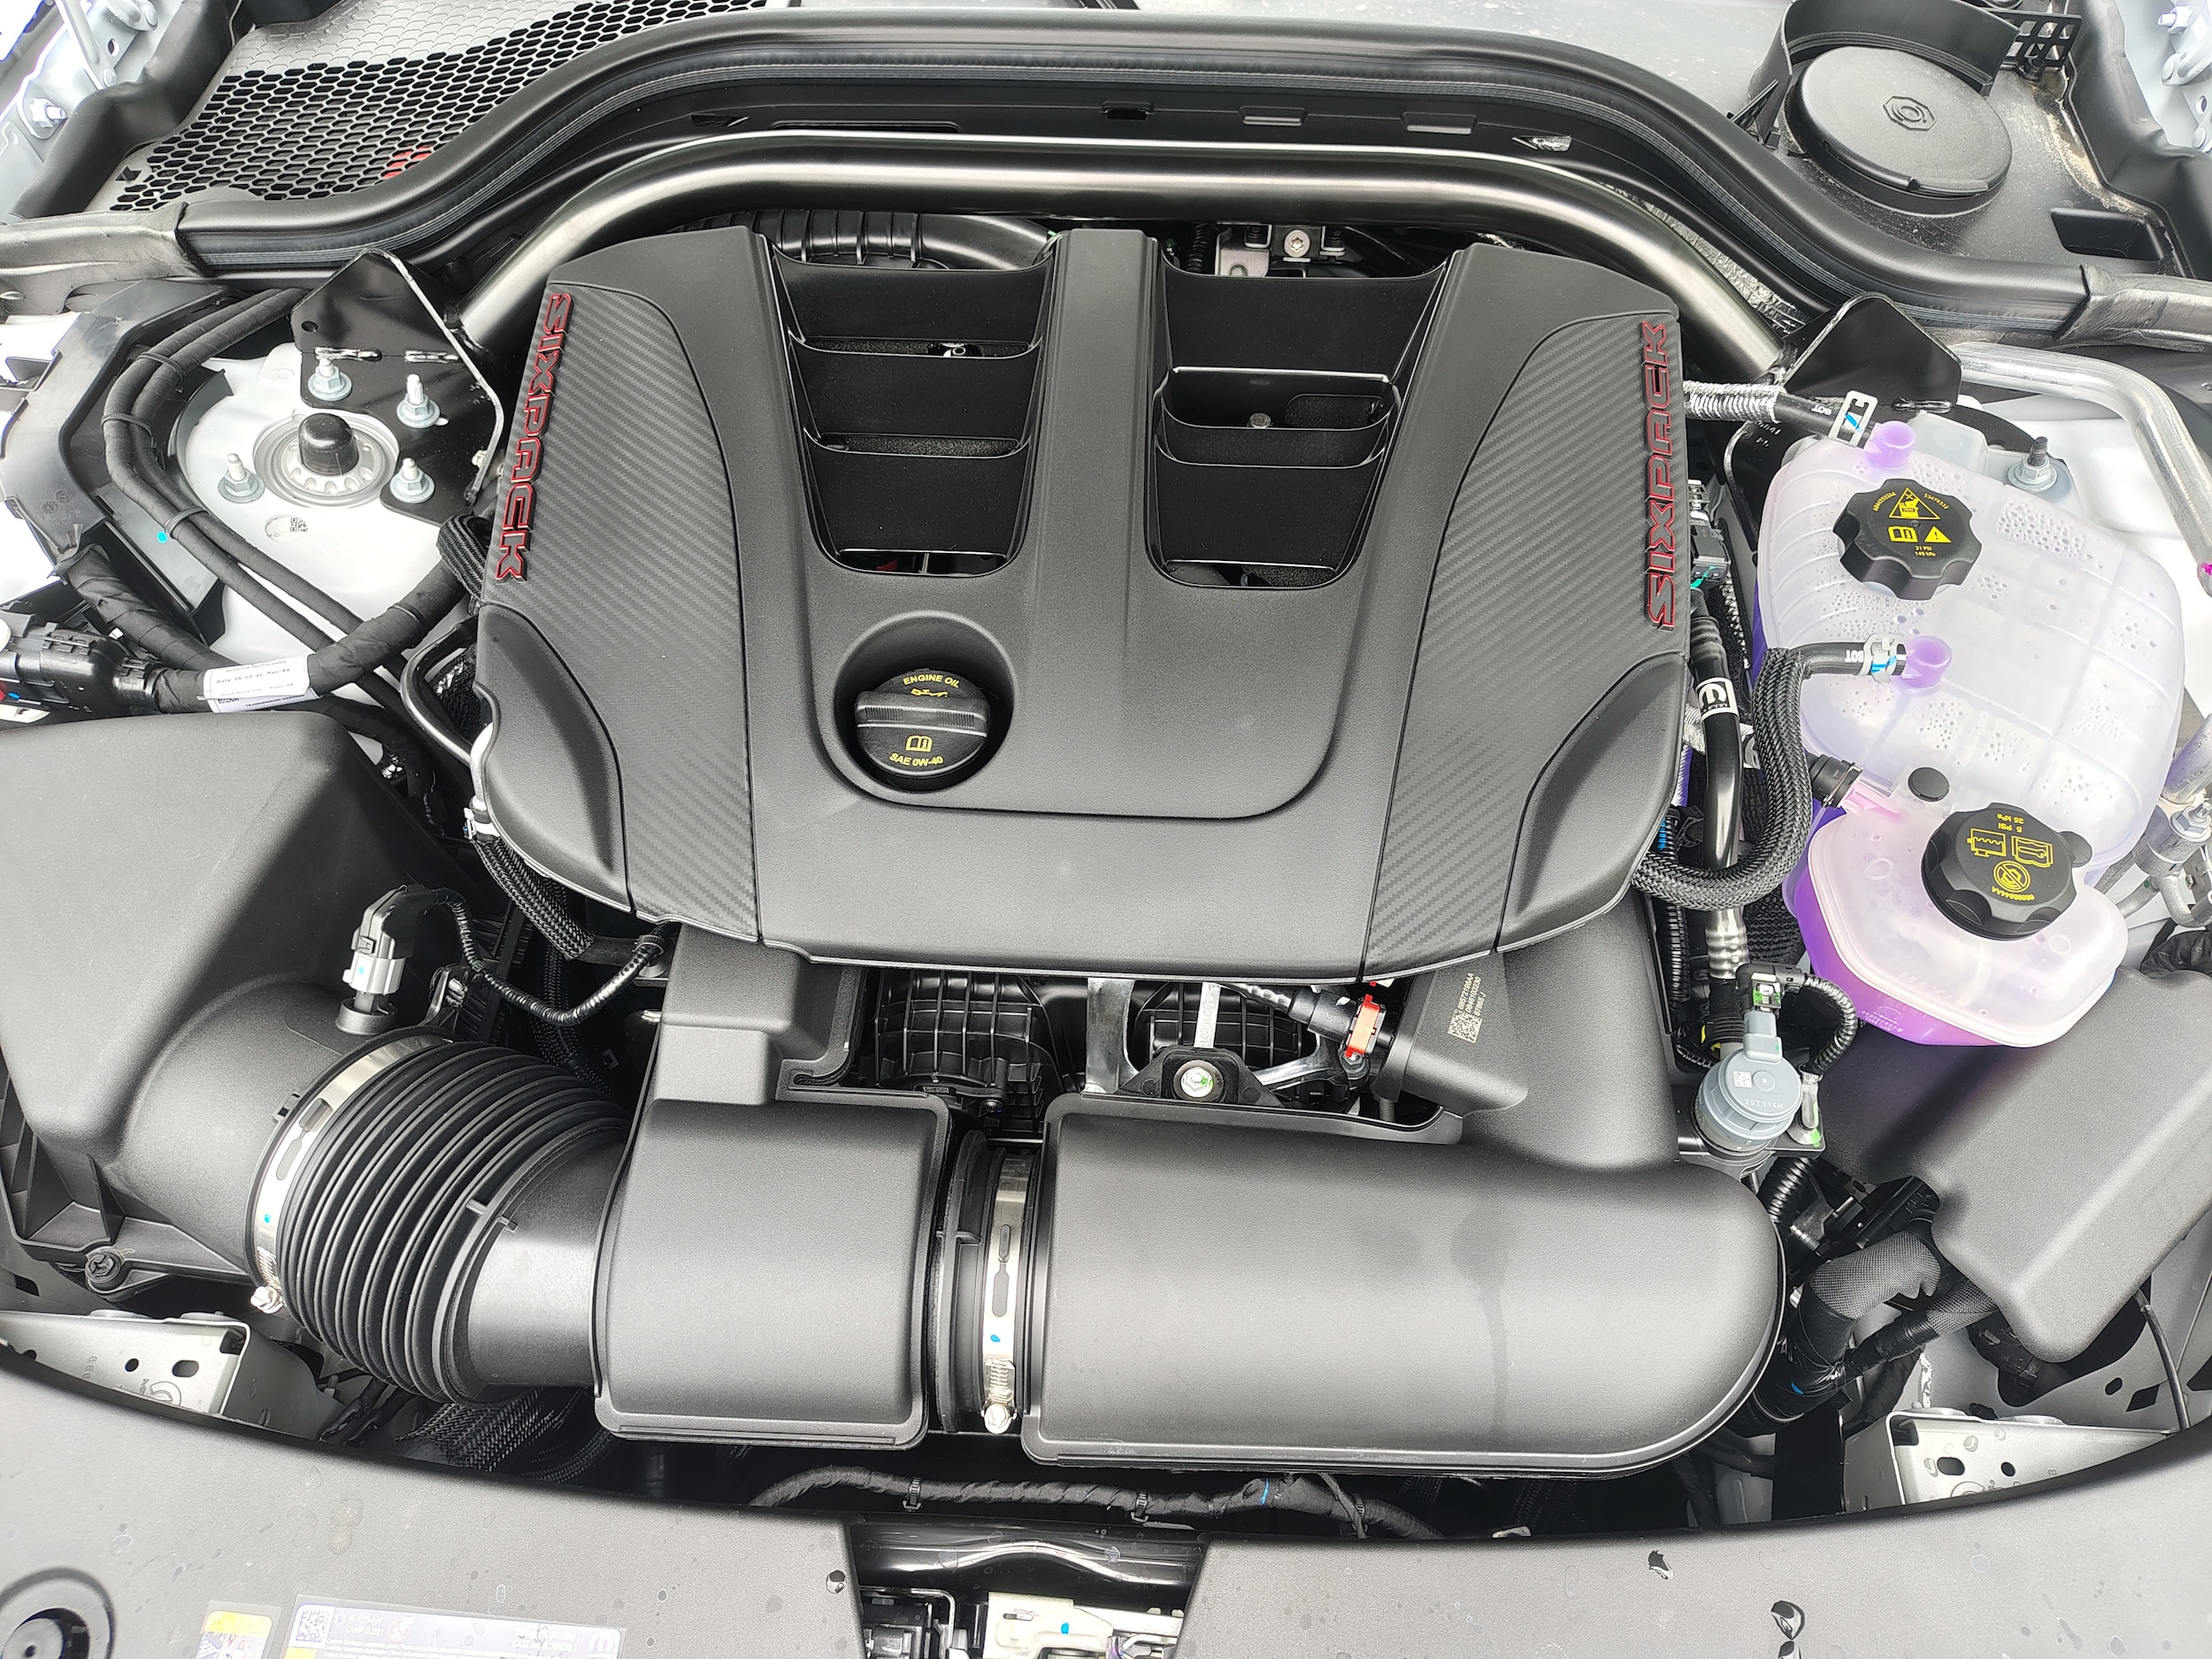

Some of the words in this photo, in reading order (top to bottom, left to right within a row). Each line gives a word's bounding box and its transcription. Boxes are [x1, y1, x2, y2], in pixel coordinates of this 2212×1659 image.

[495, 292, 572, 581] SIXPACK
[1641, 321, 1675, 629] SIXPACK
[902, 674, 943, 685] ENGINE
[944, 677, 960, 688] OIL
[889, 752, 910, 766] SAE
[912, 756, 943, 766] 0W-40
[345, 1624, 365, 1635] GWP
